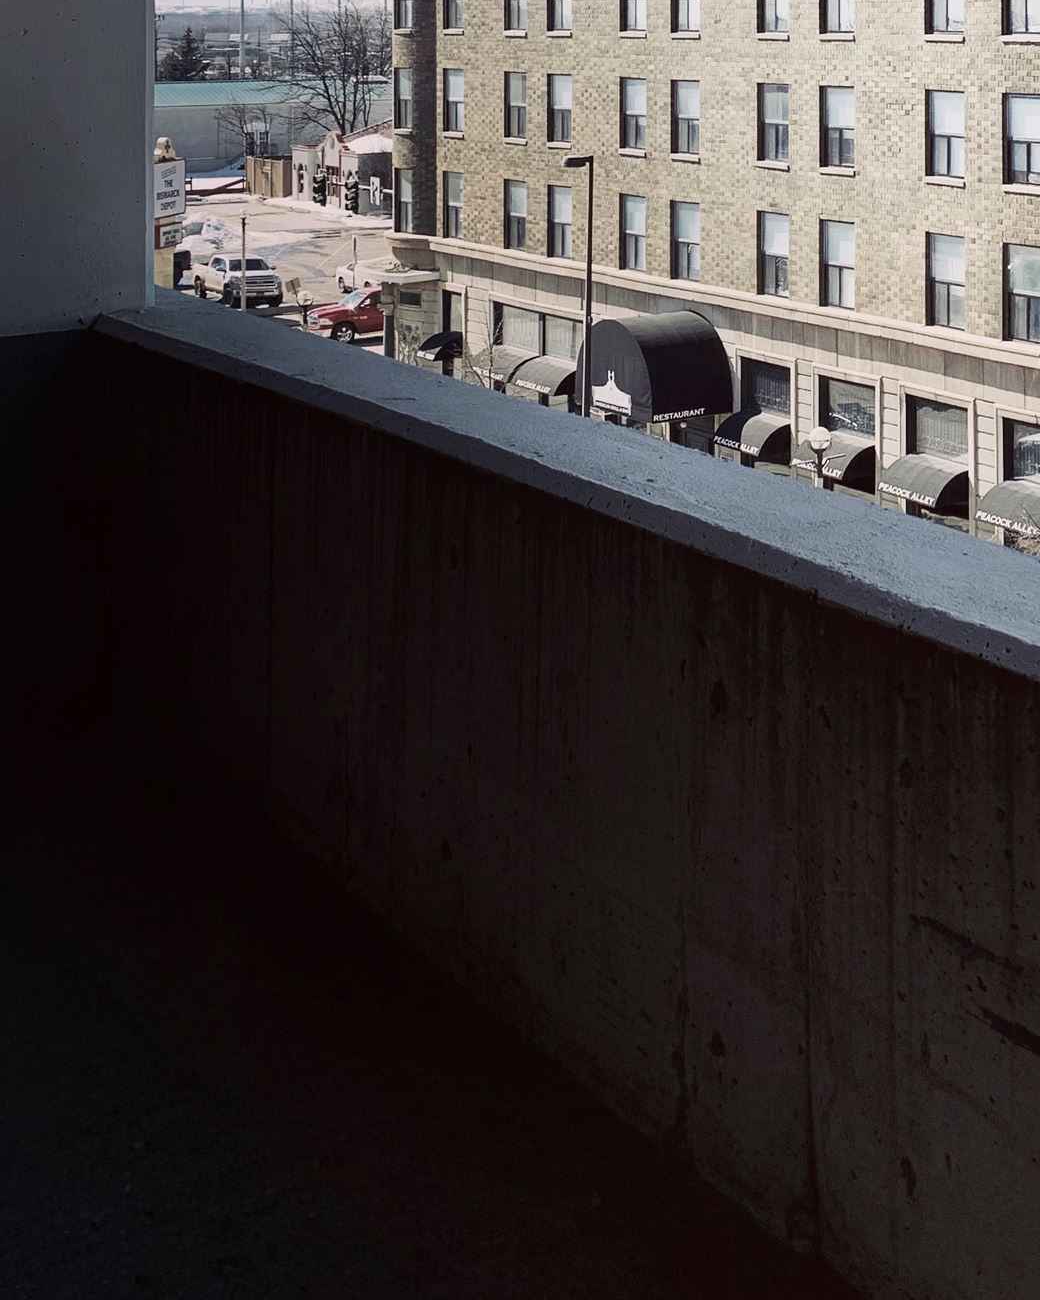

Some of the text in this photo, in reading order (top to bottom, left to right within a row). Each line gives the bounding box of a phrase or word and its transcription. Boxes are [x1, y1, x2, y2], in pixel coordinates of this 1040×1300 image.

[164, 179, 173, 187] THE
[156, 189, 180, 200] BISMARCK
[160, 201, 176, 211] DEPOT
[653, 408, 705, 422] RESTAURANT
[713, 435, 760, 454] PEACOCK ALLEY
[878, 482, 936, 506] PEACOCK ALLEY
[975, 510, 1038, 535] PEACOCK ALLEY
